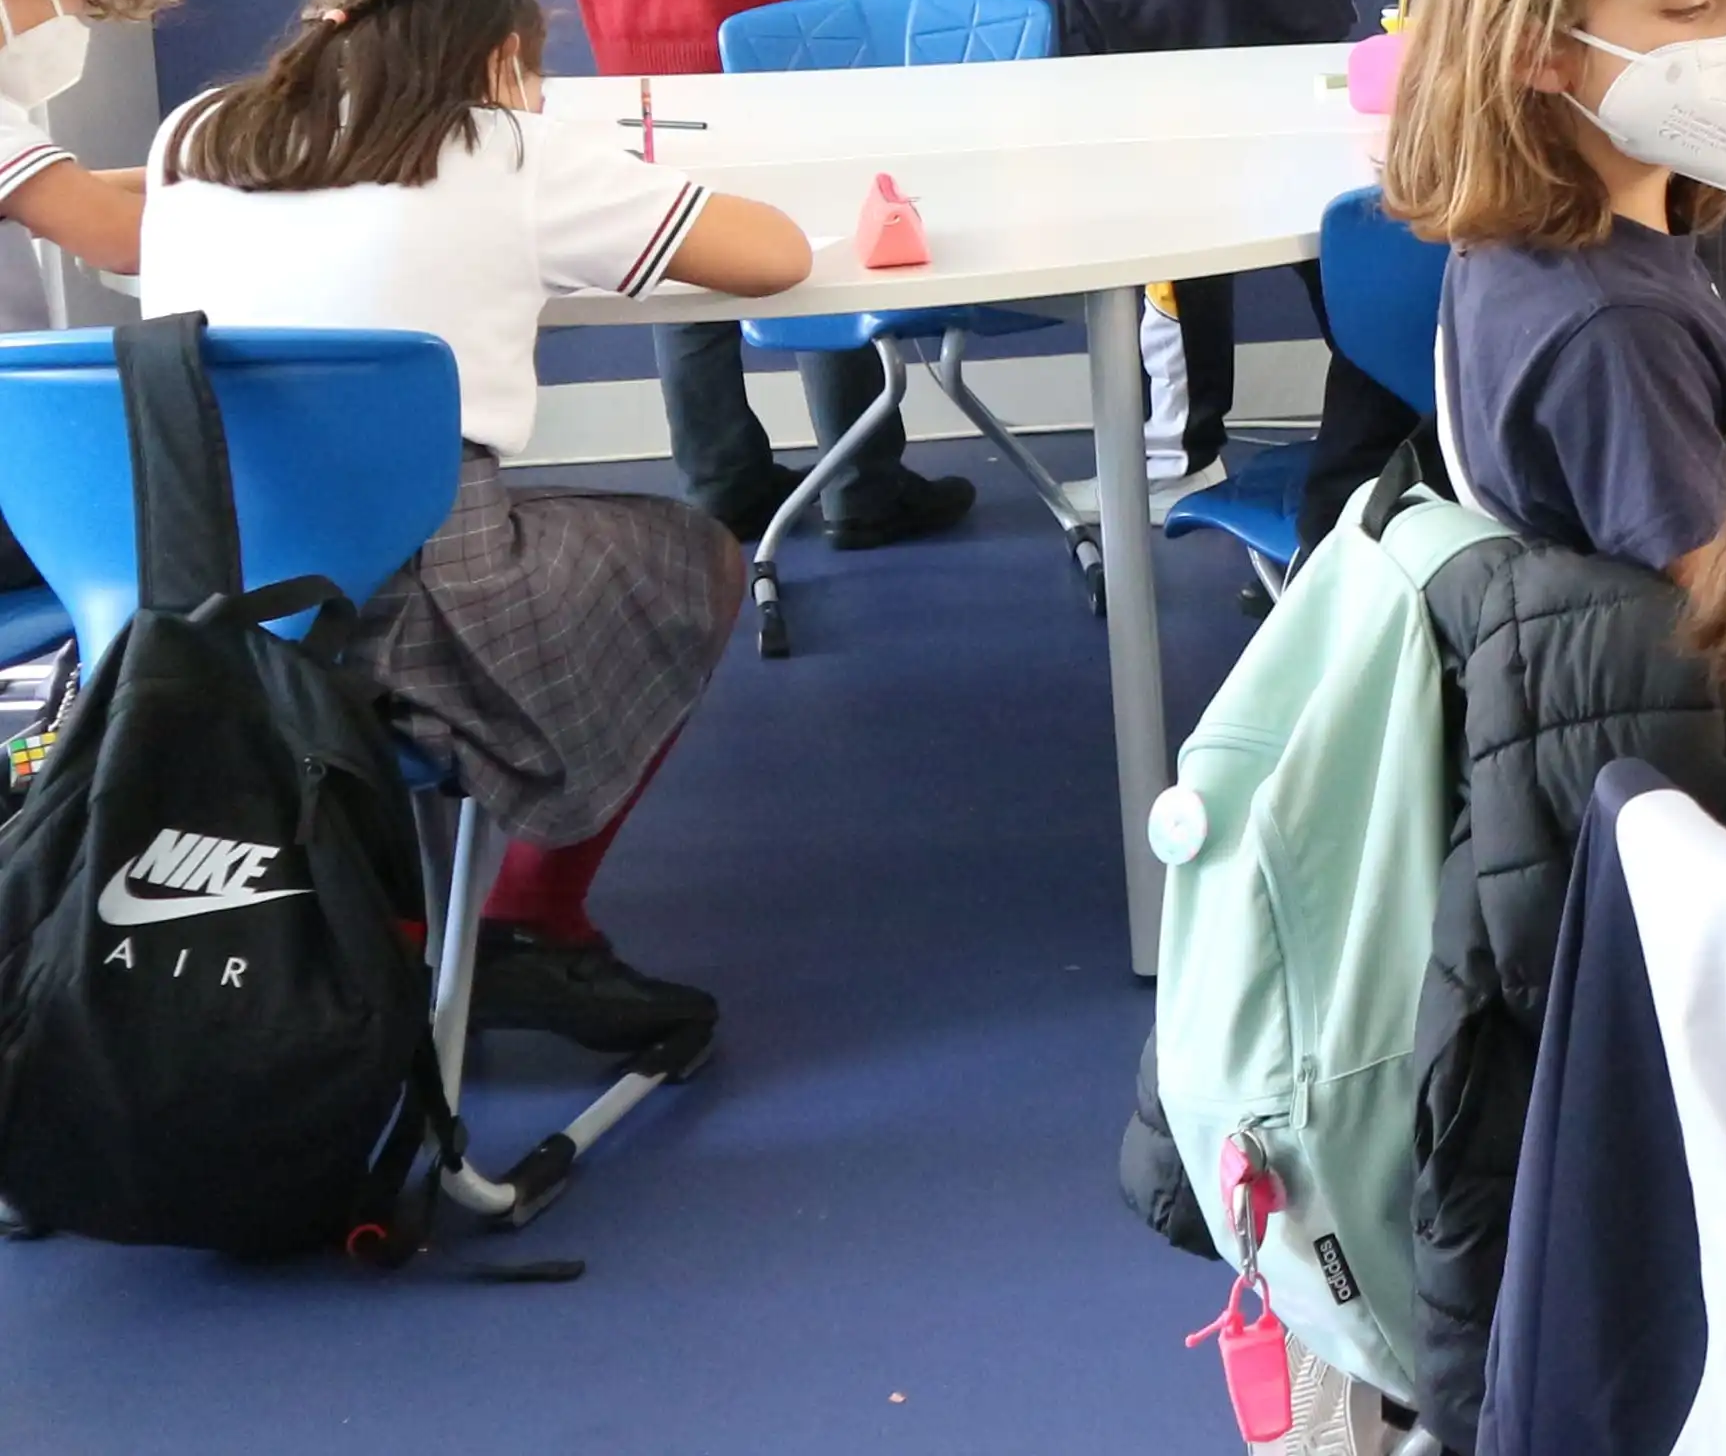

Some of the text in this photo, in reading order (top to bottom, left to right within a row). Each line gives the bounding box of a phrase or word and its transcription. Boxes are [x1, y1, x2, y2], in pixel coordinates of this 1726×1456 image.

[128, 828, 281, 895] NIKE
[104, 935, 249, 988] AIR
[1321, 1240, 1351, 1300] adidas
